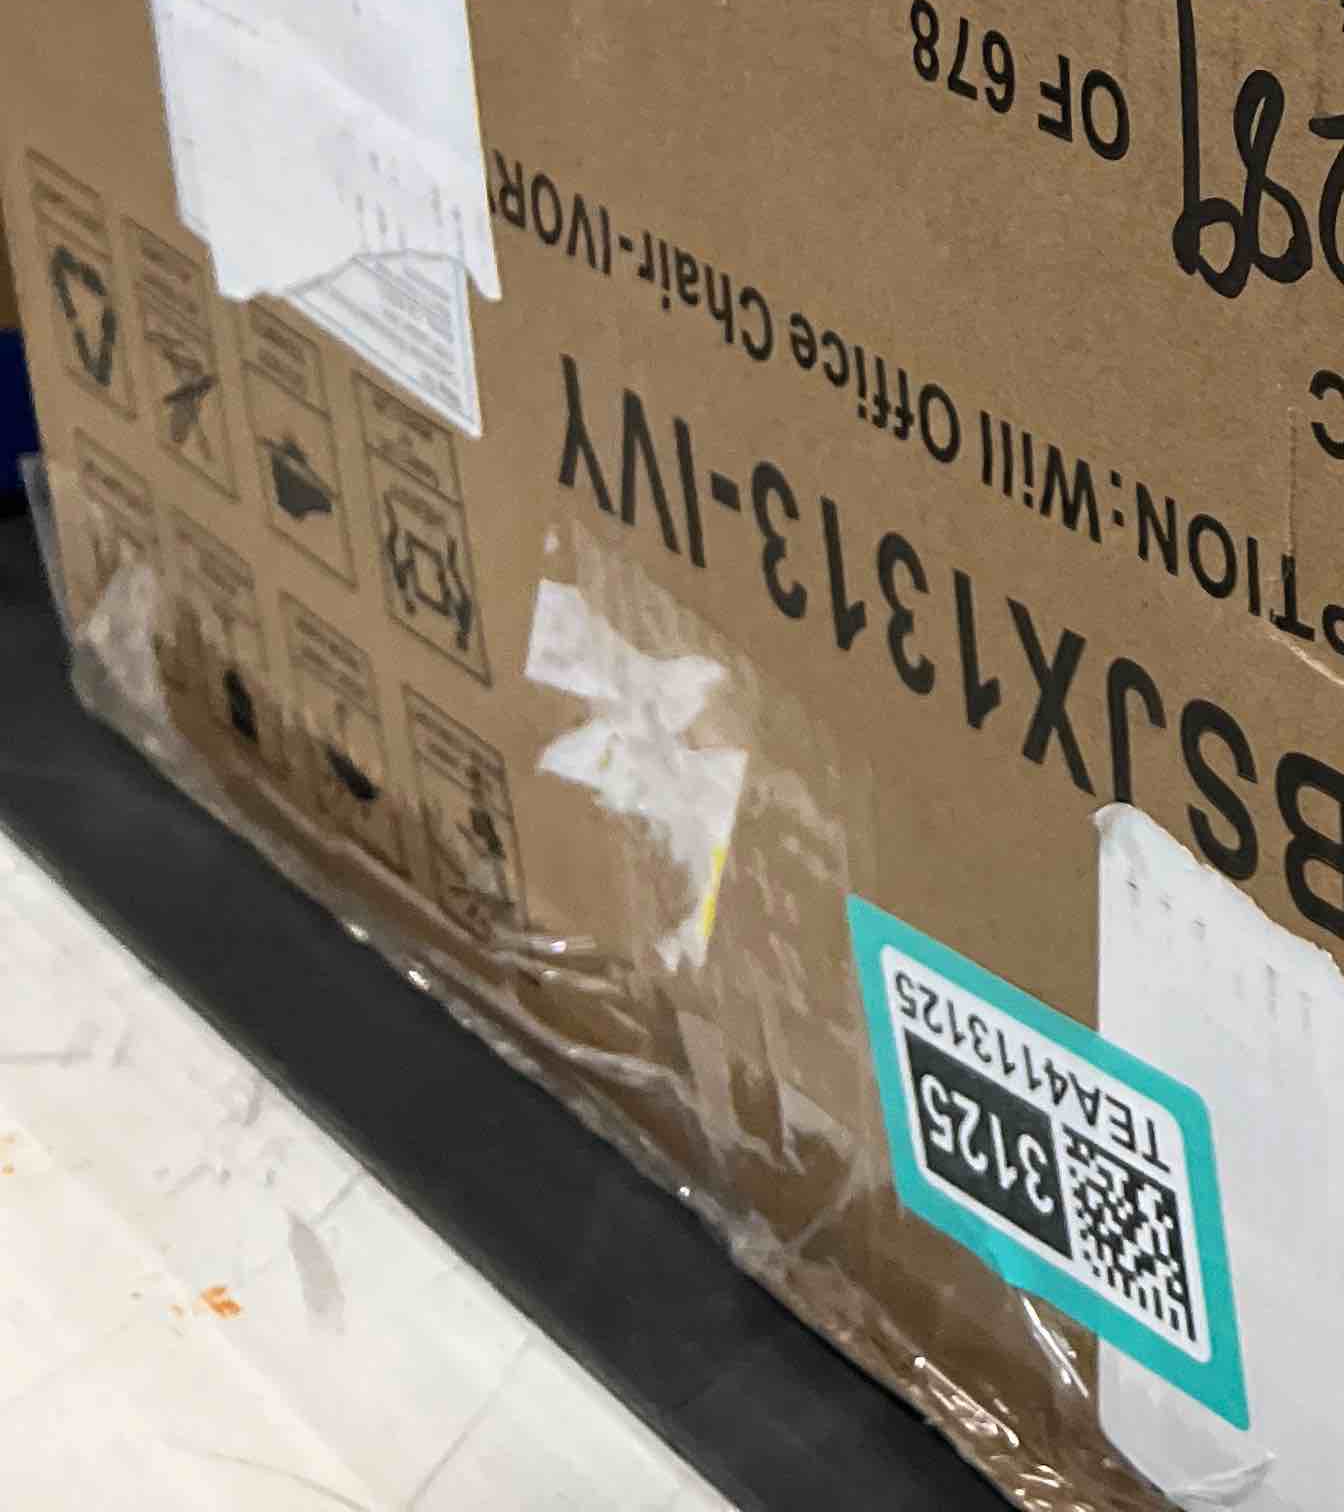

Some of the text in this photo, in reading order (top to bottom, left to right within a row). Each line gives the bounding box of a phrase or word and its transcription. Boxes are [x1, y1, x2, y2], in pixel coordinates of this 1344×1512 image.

[1038, 55, 1130, 161] OF
[790, 313, 961, 464] Office
[894, 971, 1170, 1174] TEA4113125
[919, 1073, 1055, 1214] 3125
